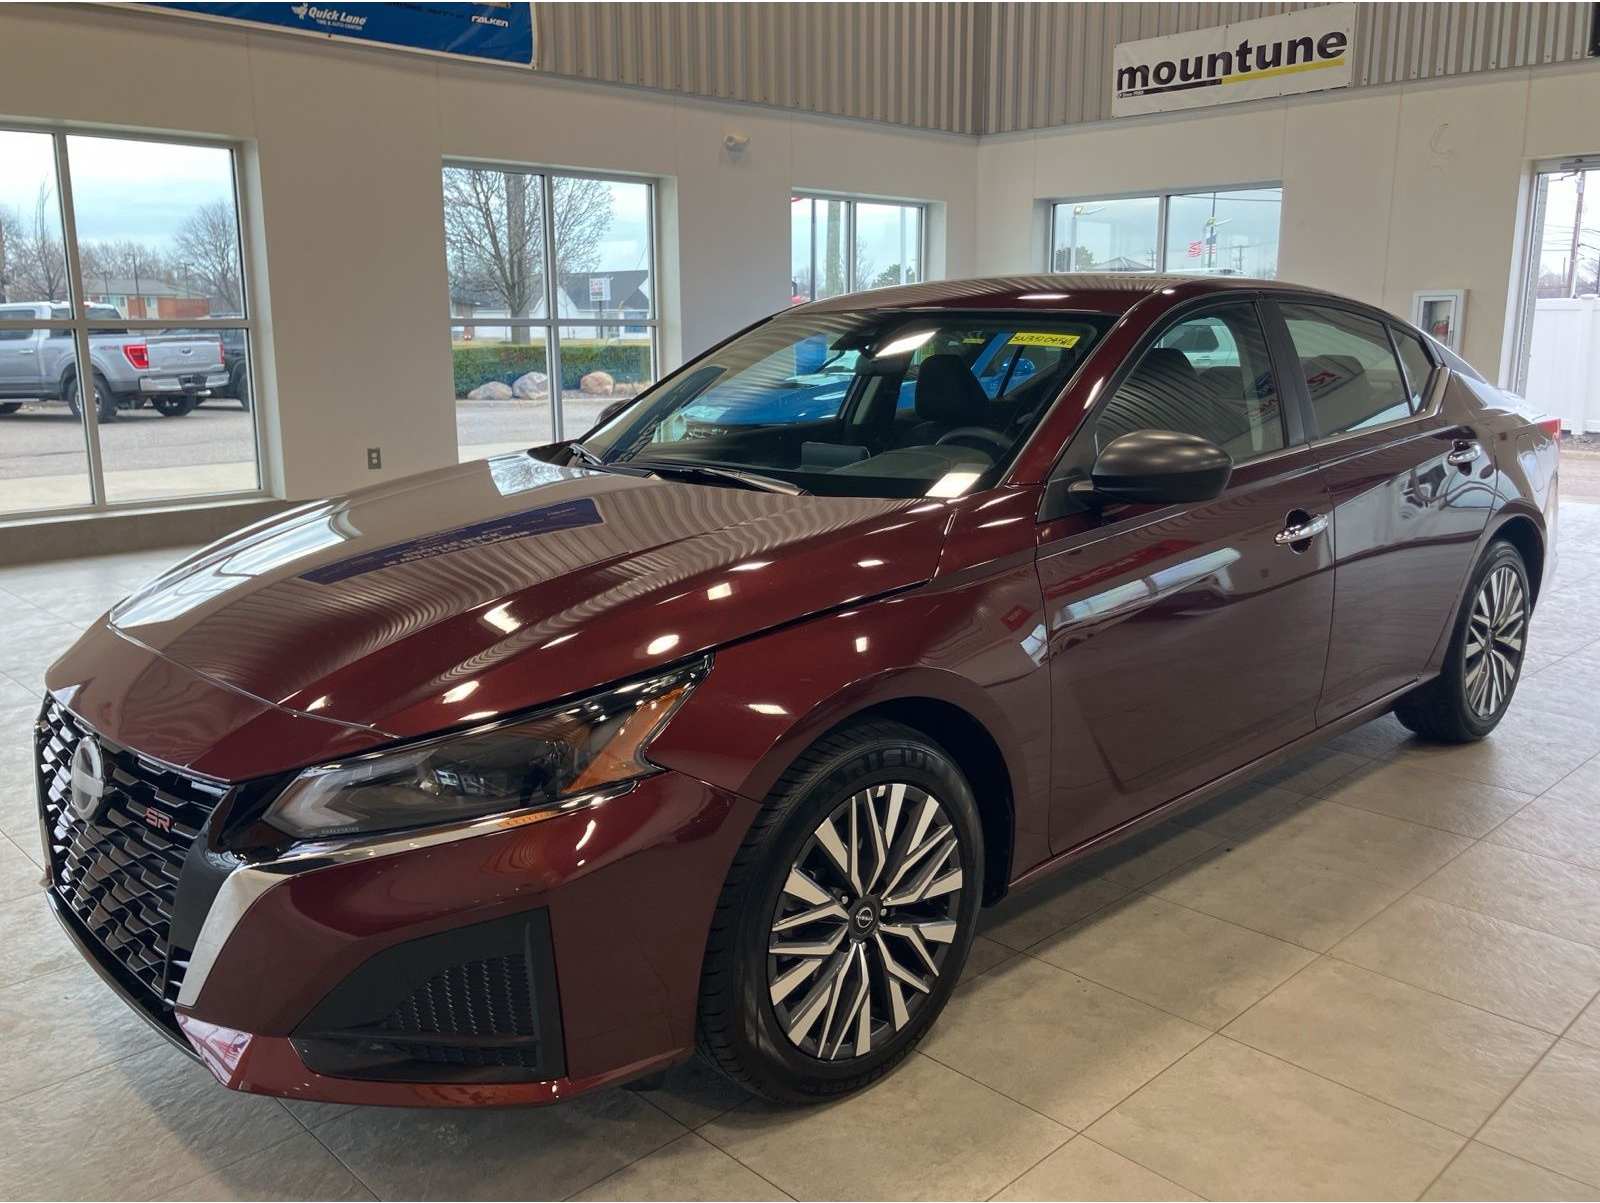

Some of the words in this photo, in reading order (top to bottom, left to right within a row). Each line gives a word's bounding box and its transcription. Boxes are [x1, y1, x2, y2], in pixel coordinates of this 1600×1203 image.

[308, 6, 338, 21] Quick
[340, 11, 367, 25] Lane
[471, 15, 509, 28] FALKEN
[1117, 31, 1348, 91] mountune
[145, 807, 171, 833] SR
